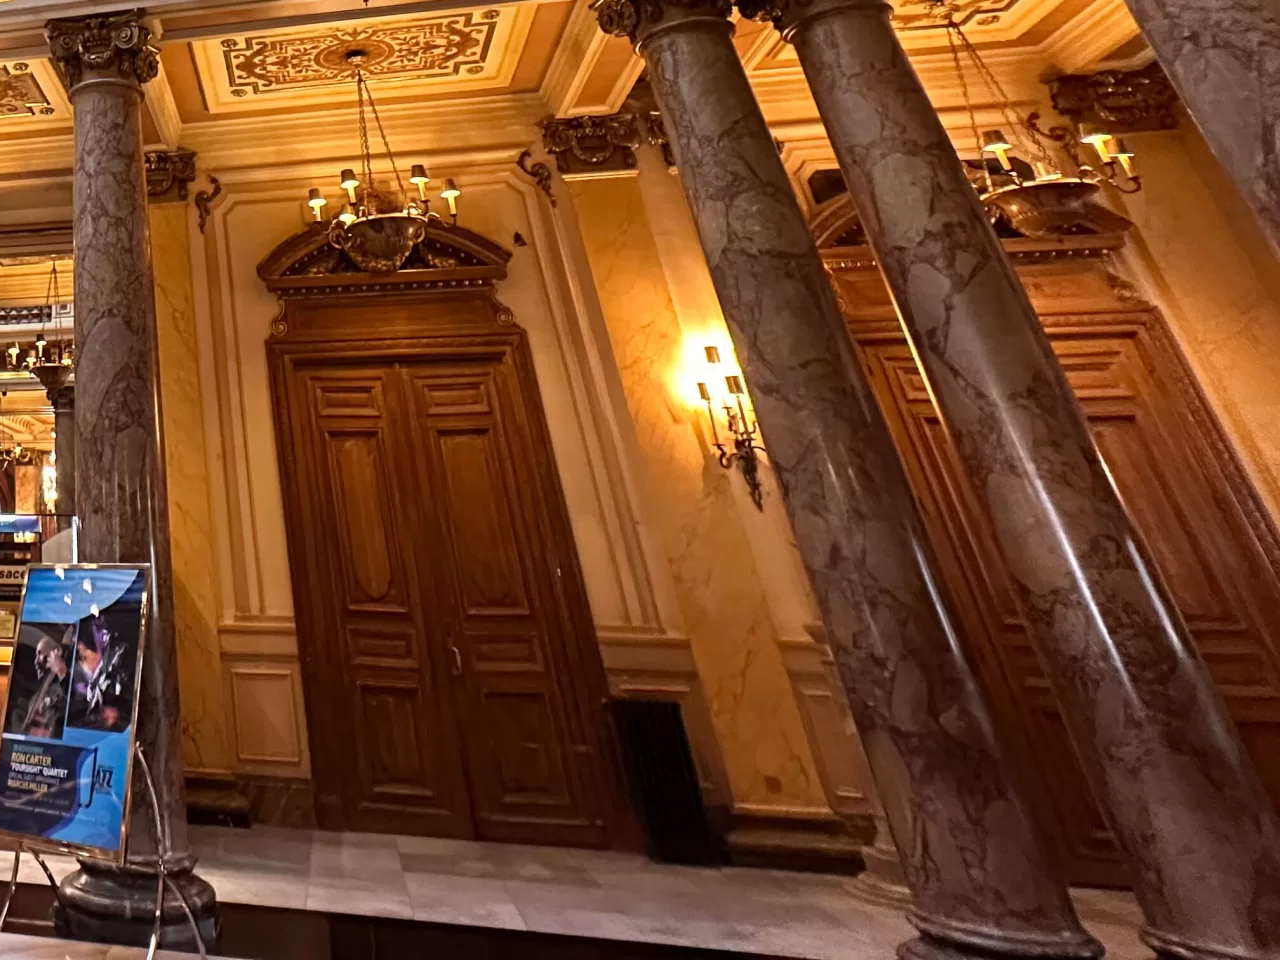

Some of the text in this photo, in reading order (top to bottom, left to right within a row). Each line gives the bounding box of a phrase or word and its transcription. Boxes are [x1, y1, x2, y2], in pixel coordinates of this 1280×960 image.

[11, 752, 52, 766] RON CARTER
[43, 766, 68, 778] QUARTET
[8, 779, 48, 792] MARCUS MILLER
